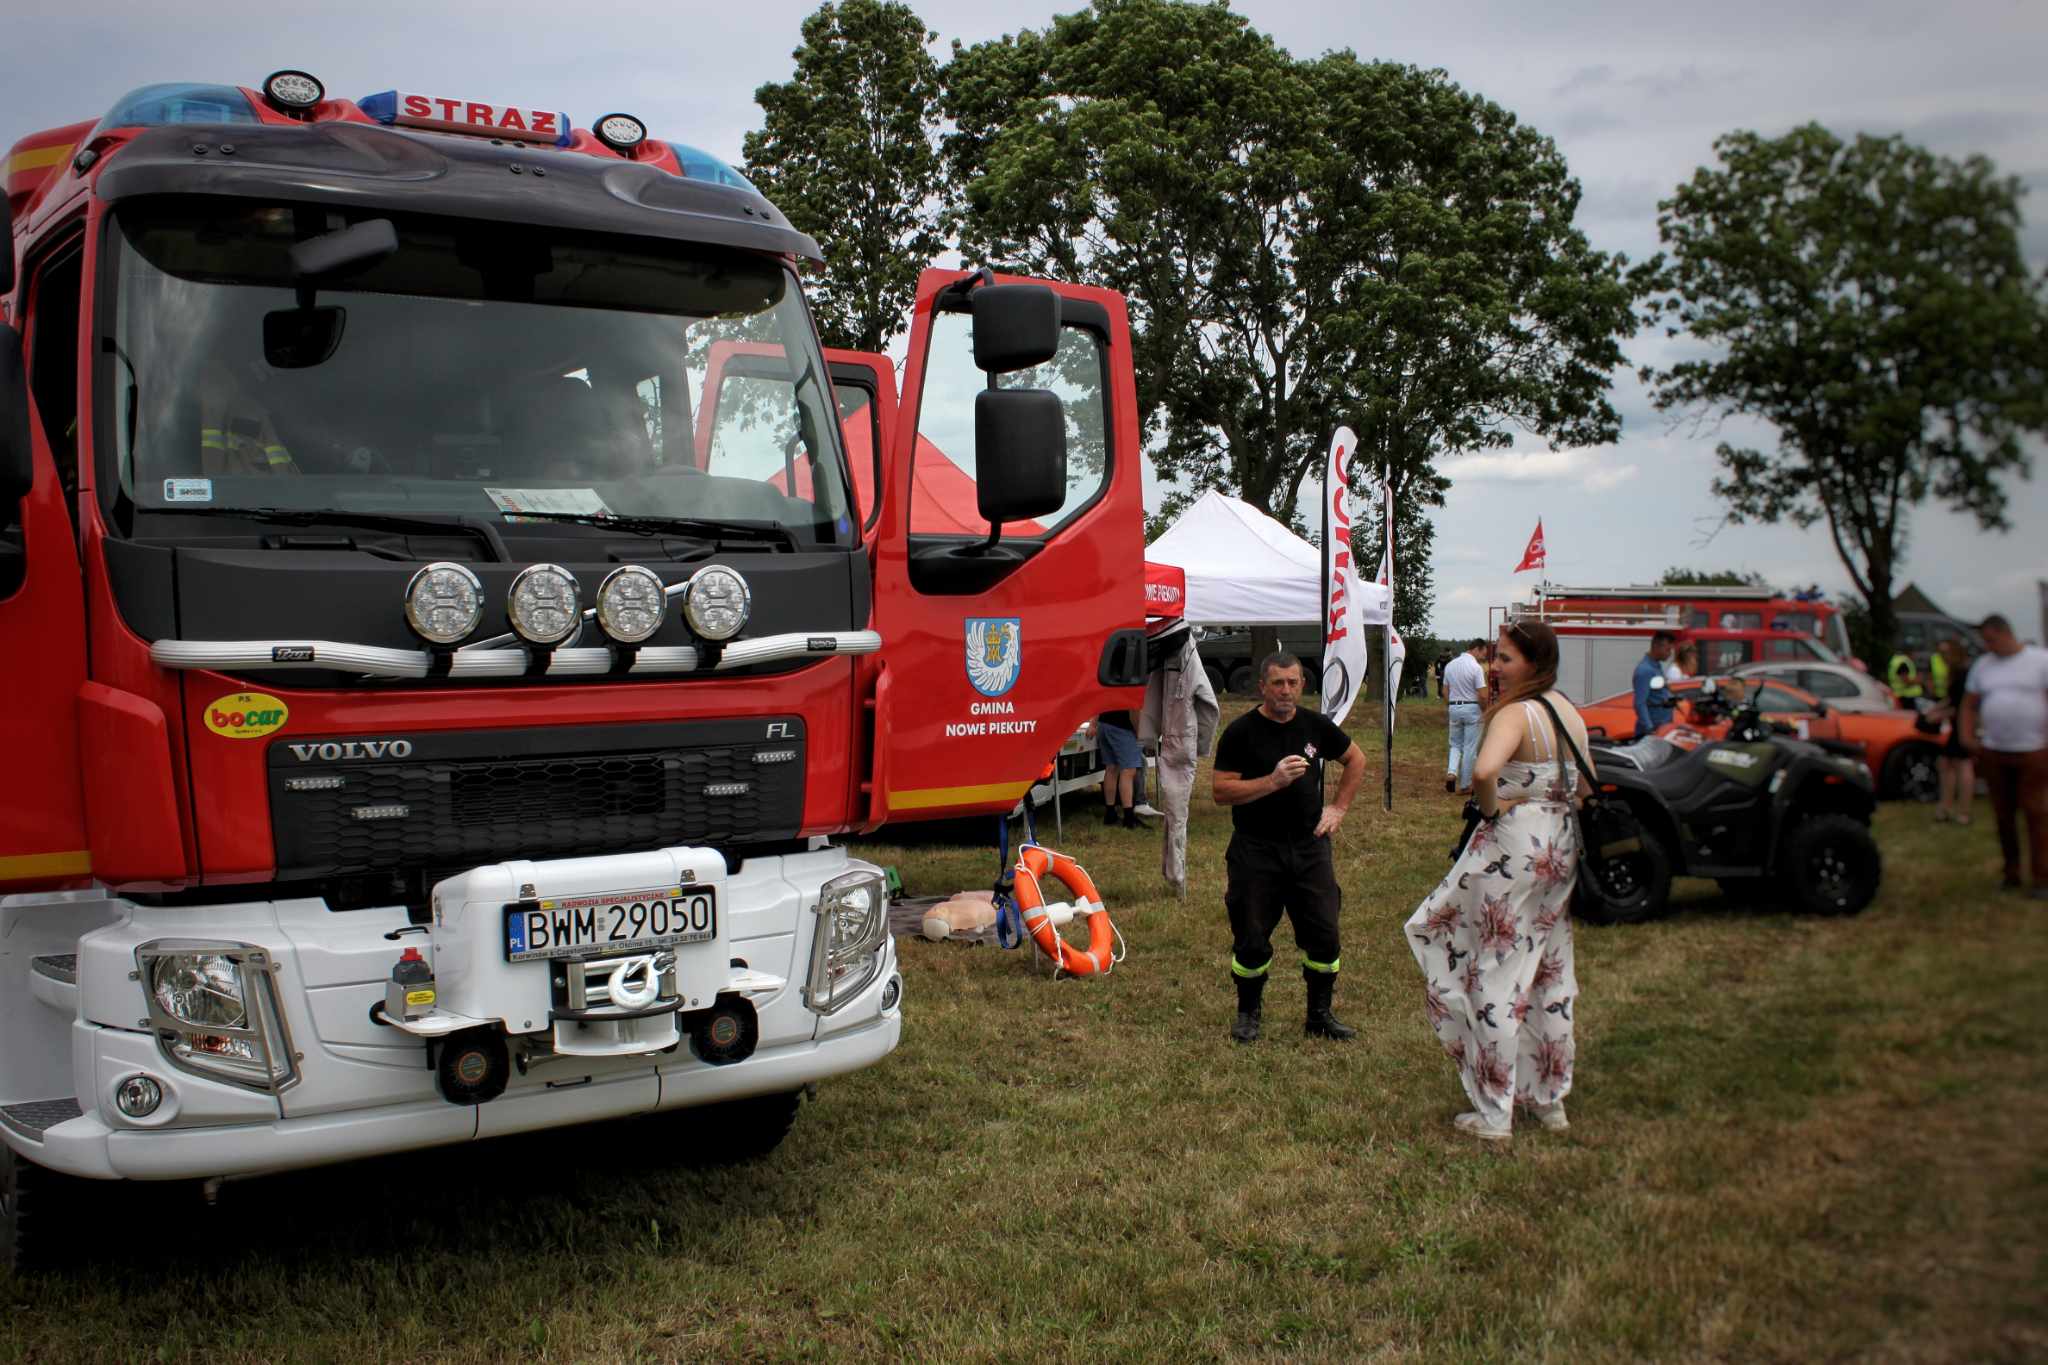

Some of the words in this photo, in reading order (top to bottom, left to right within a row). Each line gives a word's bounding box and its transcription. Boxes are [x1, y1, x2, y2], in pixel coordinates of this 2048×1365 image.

[970, 701, 1015, 715] GMINA
[211, 708, 284, 728] bocar
[766, 722, 796, 739] FL
[945, 722, 986, 737] NOWE
[989, 720, 1037, 735] PIEKUTY
[288, 740, 413, 761] VOLVO
[510, 938, 524, 949] PL
[528, 907, 596, 950] BWM
[608, 896, 709, 942] 29050
